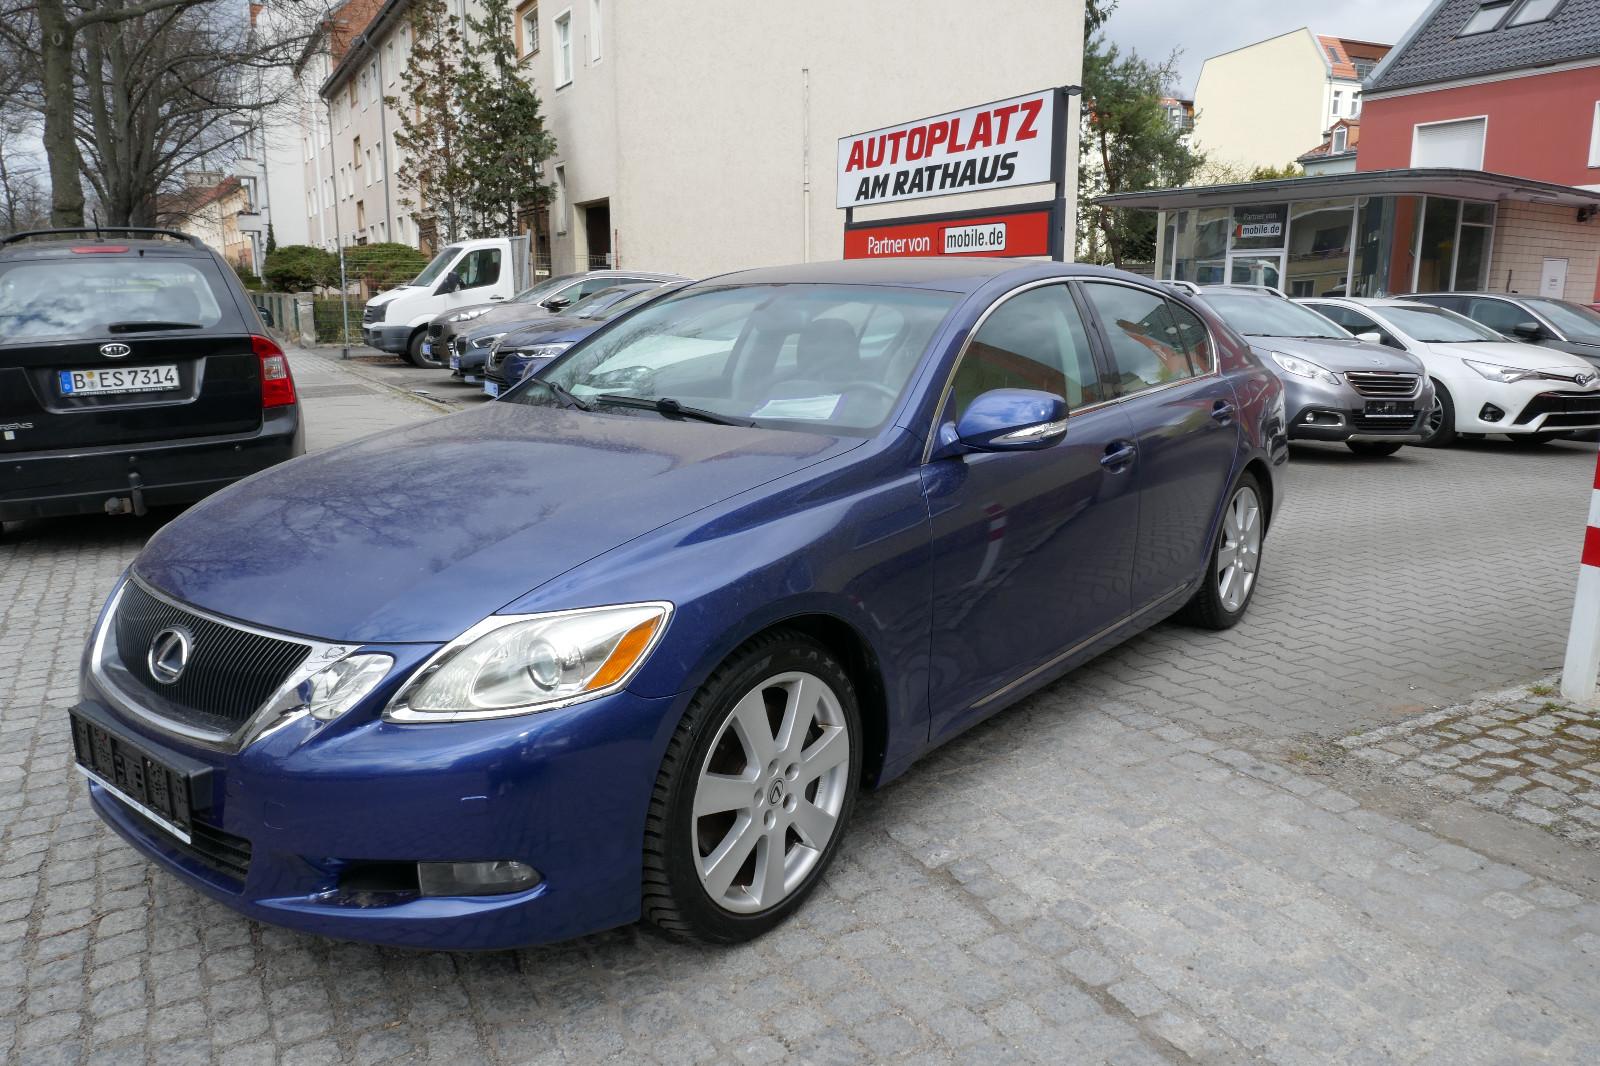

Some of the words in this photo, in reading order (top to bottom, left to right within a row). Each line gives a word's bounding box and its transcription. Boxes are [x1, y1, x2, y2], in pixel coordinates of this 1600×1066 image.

[845, 99, 1043, 172] AUTOPLATZ
[855, 173, 890, 201] AM
[892, 151, 1018, 196] RATHAUS
[867, 236, 907, 255] Partner
[908, 236, 930, 252] von
[946, 228, 1003, 249] mobile.de
[1243, 224, 1280, 235] mobile.de
[104, 346, 126, 355] KIA
[73, 373, 86, 390] B
[99, 371, 125, 388] ES
[127, 368, 175, 386] 7314
